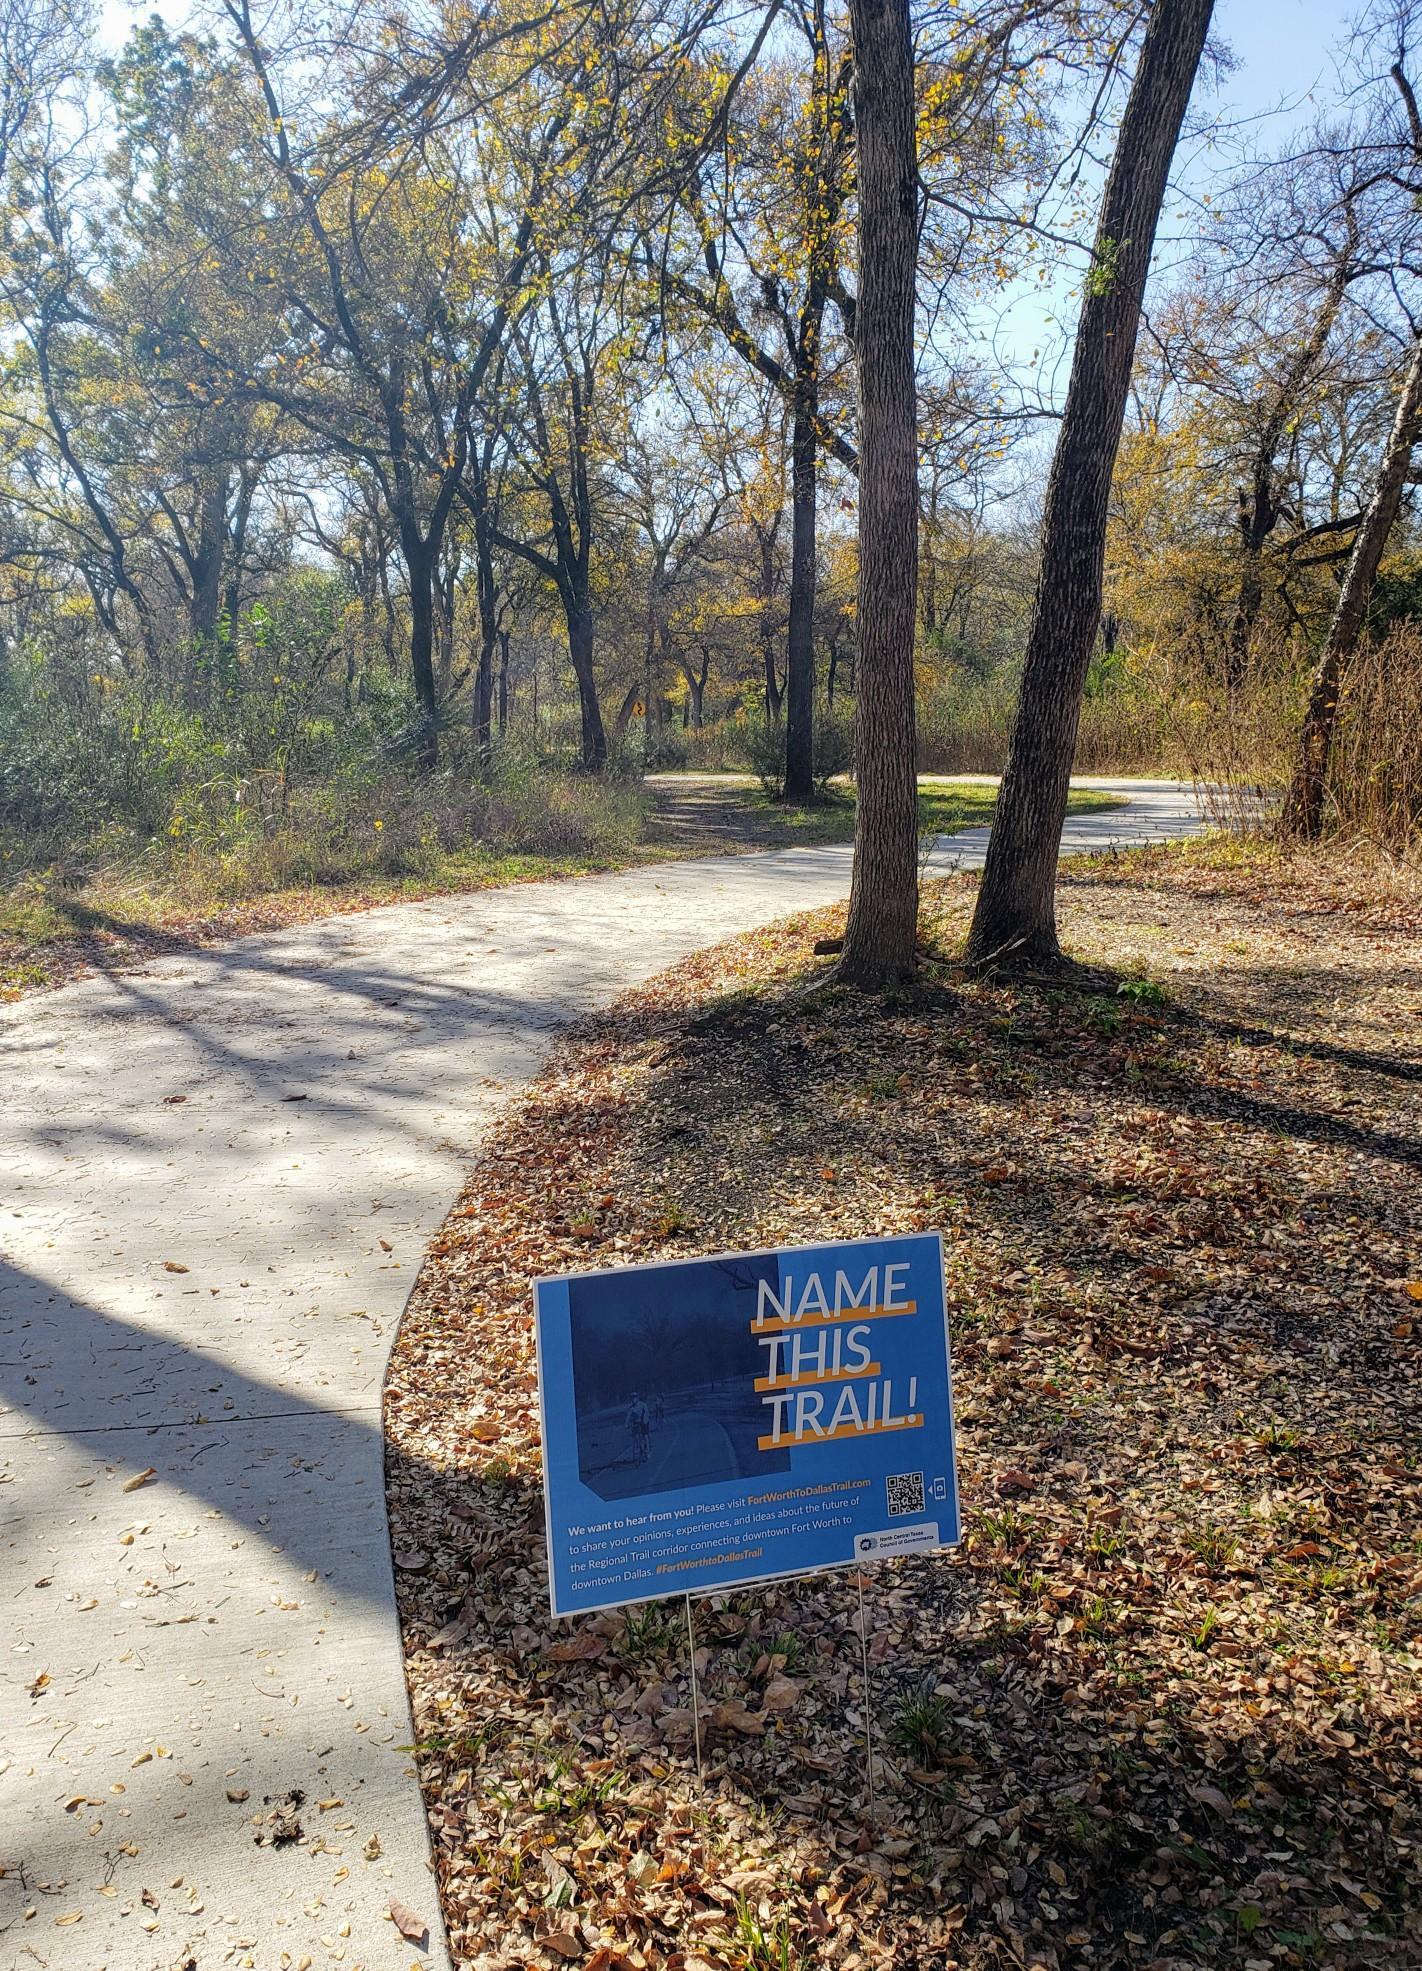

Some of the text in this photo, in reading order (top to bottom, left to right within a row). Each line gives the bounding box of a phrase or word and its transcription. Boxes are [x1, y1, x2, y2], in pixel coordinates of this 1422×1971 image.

[756, 1262, 911, 1327] NAME
[758, 1325, 871, 1385] THIS
[762, 1376, 917, 1444] TRAIL!
[568, 1479, 871, 1537] We want to hear from you! Please visit FortWorthToDallasTrail.com
[569, 1495, 861, 1555] to share your opinions, experiences, and ideas about the future of
[570, 1515, 852, 1573] the Regional Trail corridor connecting downtown Fort Worth to
[571, 1547, 763, 1591] downtown Dallas. #FortWorthtoDallasTrail
